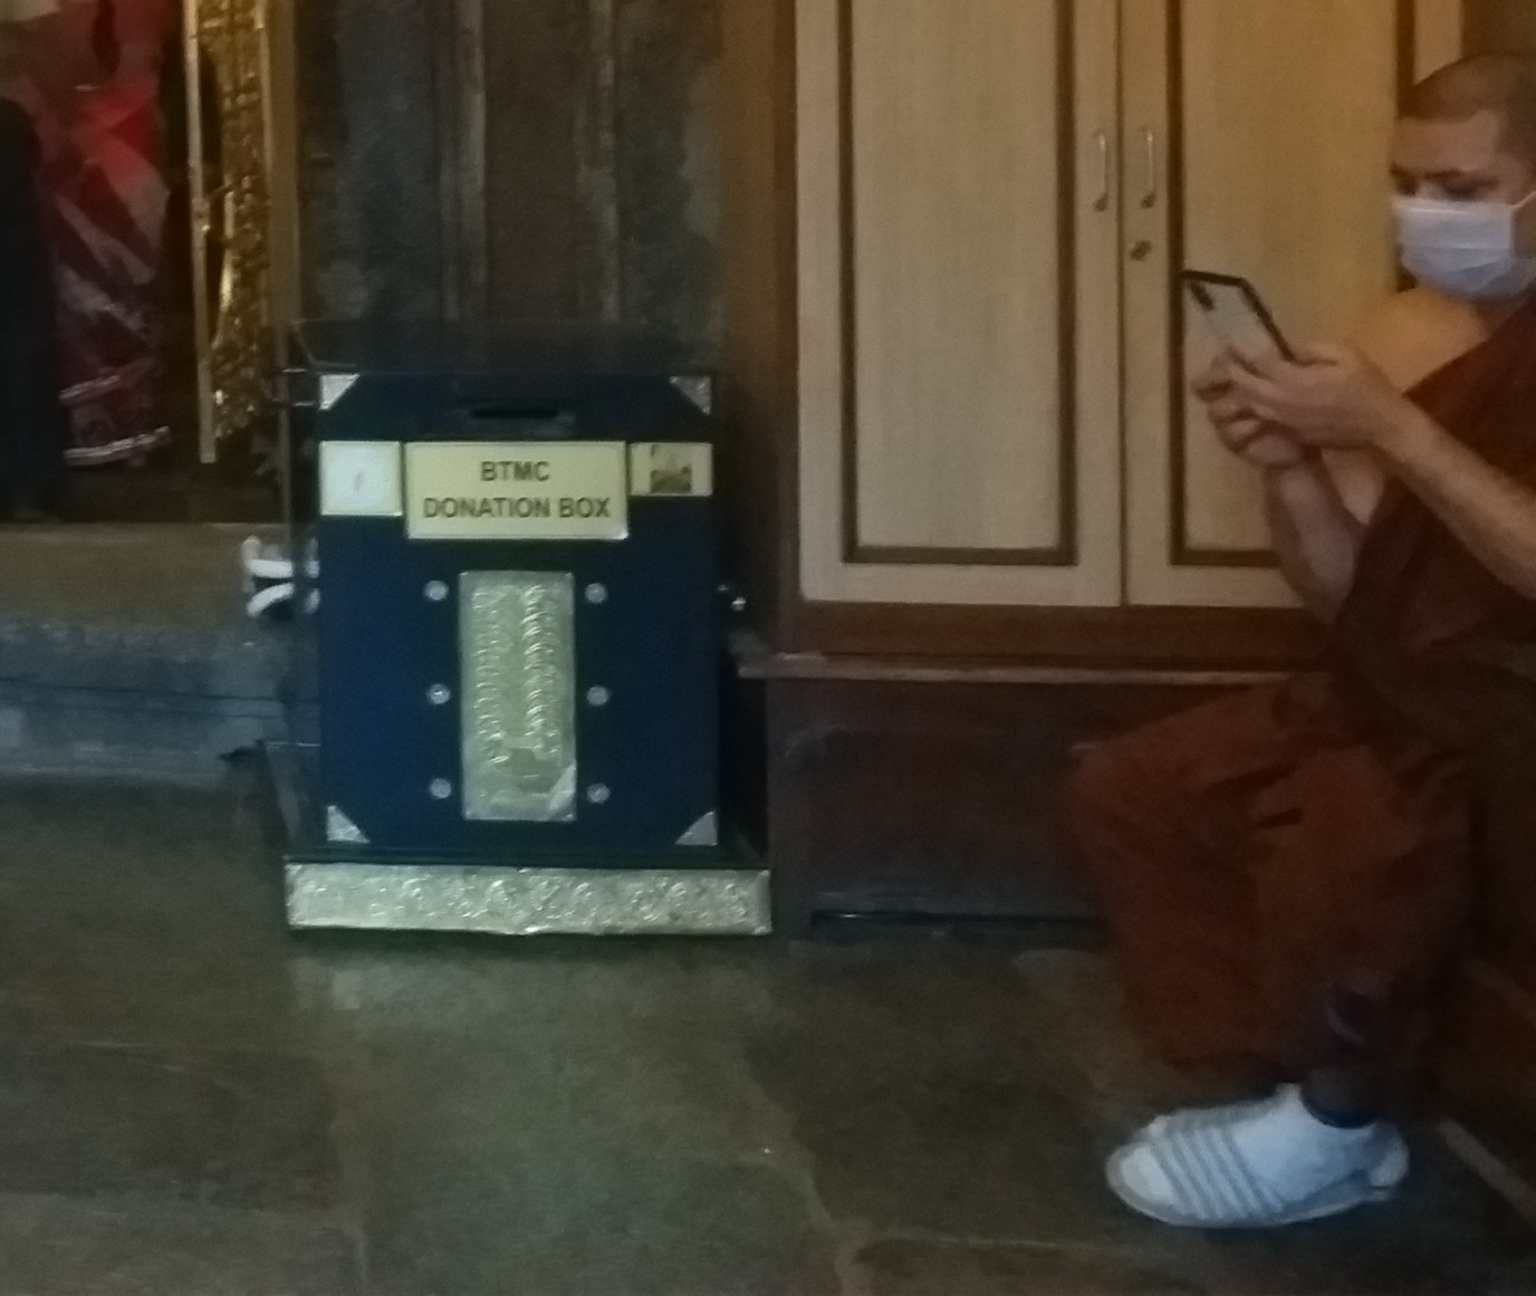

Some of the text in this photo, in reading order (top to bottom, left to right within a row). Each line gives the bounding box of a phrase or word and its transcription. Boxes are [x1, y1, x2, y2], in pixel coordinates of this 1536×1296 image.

[480, 461, 550, 482] BTMC
[423, 497, 610, 519] DONATION BOX
